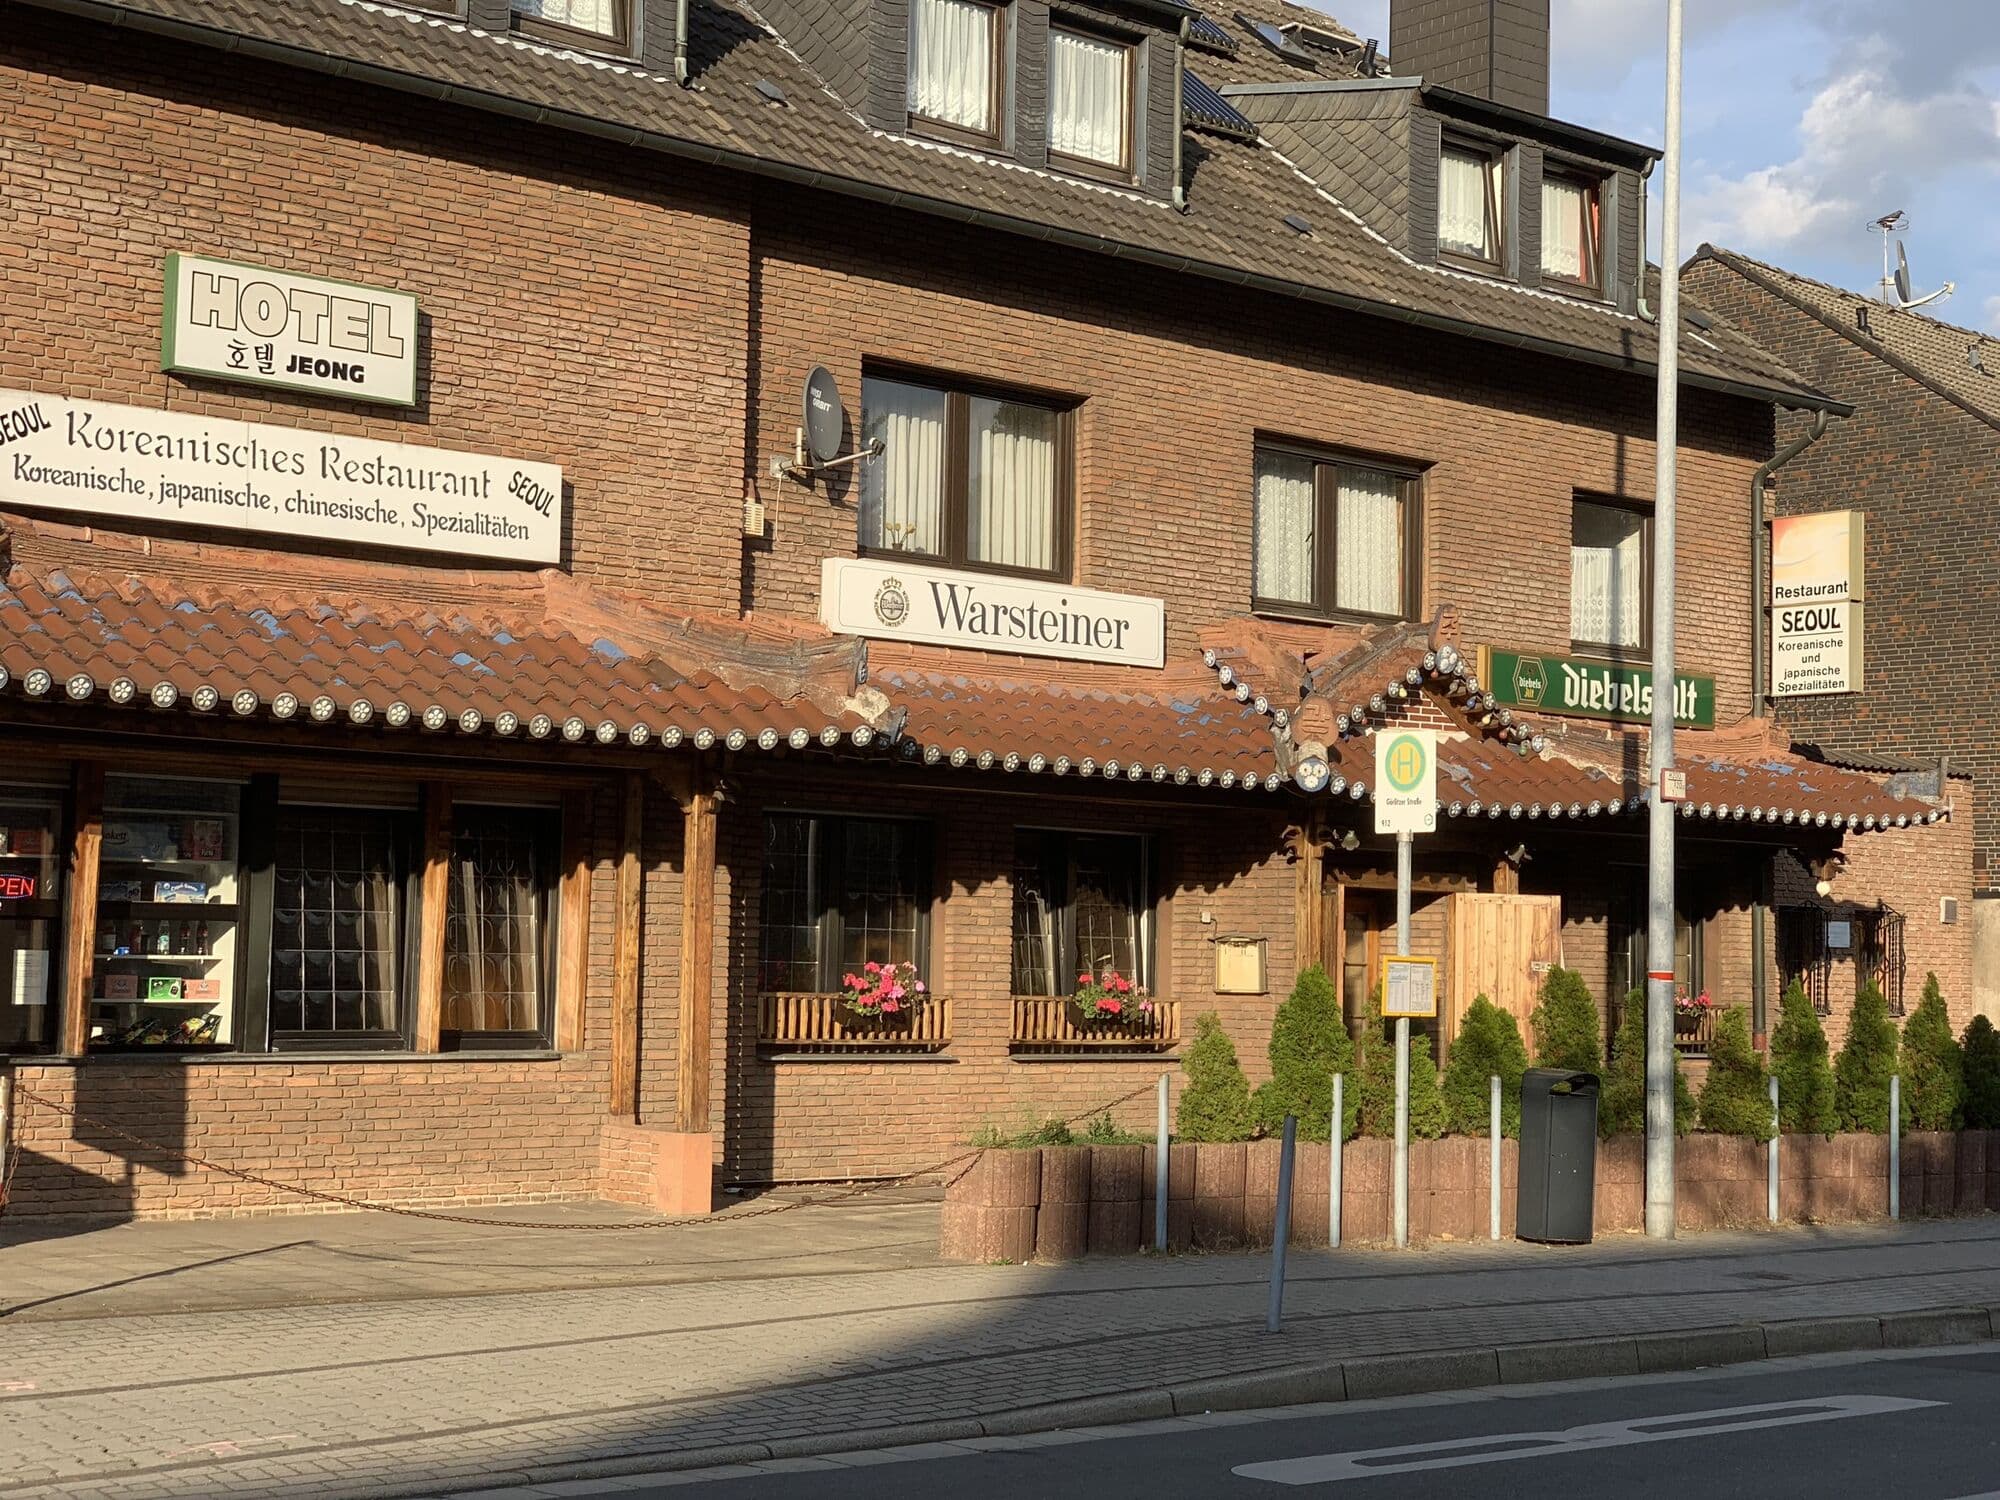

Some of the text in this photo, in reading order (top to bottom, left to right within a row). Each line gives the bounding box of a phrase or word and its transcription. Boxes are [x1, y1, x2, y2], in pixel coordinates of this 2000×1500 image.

[190, 271, 404, 359] HOTEL
[226, 338, 365, 384] 호텔 JEONG
[65, 410, 491, 499] Koreanisches Restaurant
[508, 470, 554, 518] SEOUL
[411, 502, 530, 541] Spezialitäten
[1775, 580, 1848, 599] Restaurant
[928, 580, 1130, 650] Warsteiner
[1782, 607, 1841, 633] SEOUL
[1778, 638, 1844, 652] Koreanische
[1801, 653, 1821, 664] und
[1778, 680, 1845, 693] Spezialitäten
[1784, 666, 1841, 680] japanische
[1561, 662, 1699, 720] Diebels lt
[1397, 748, 1414, 779] H
